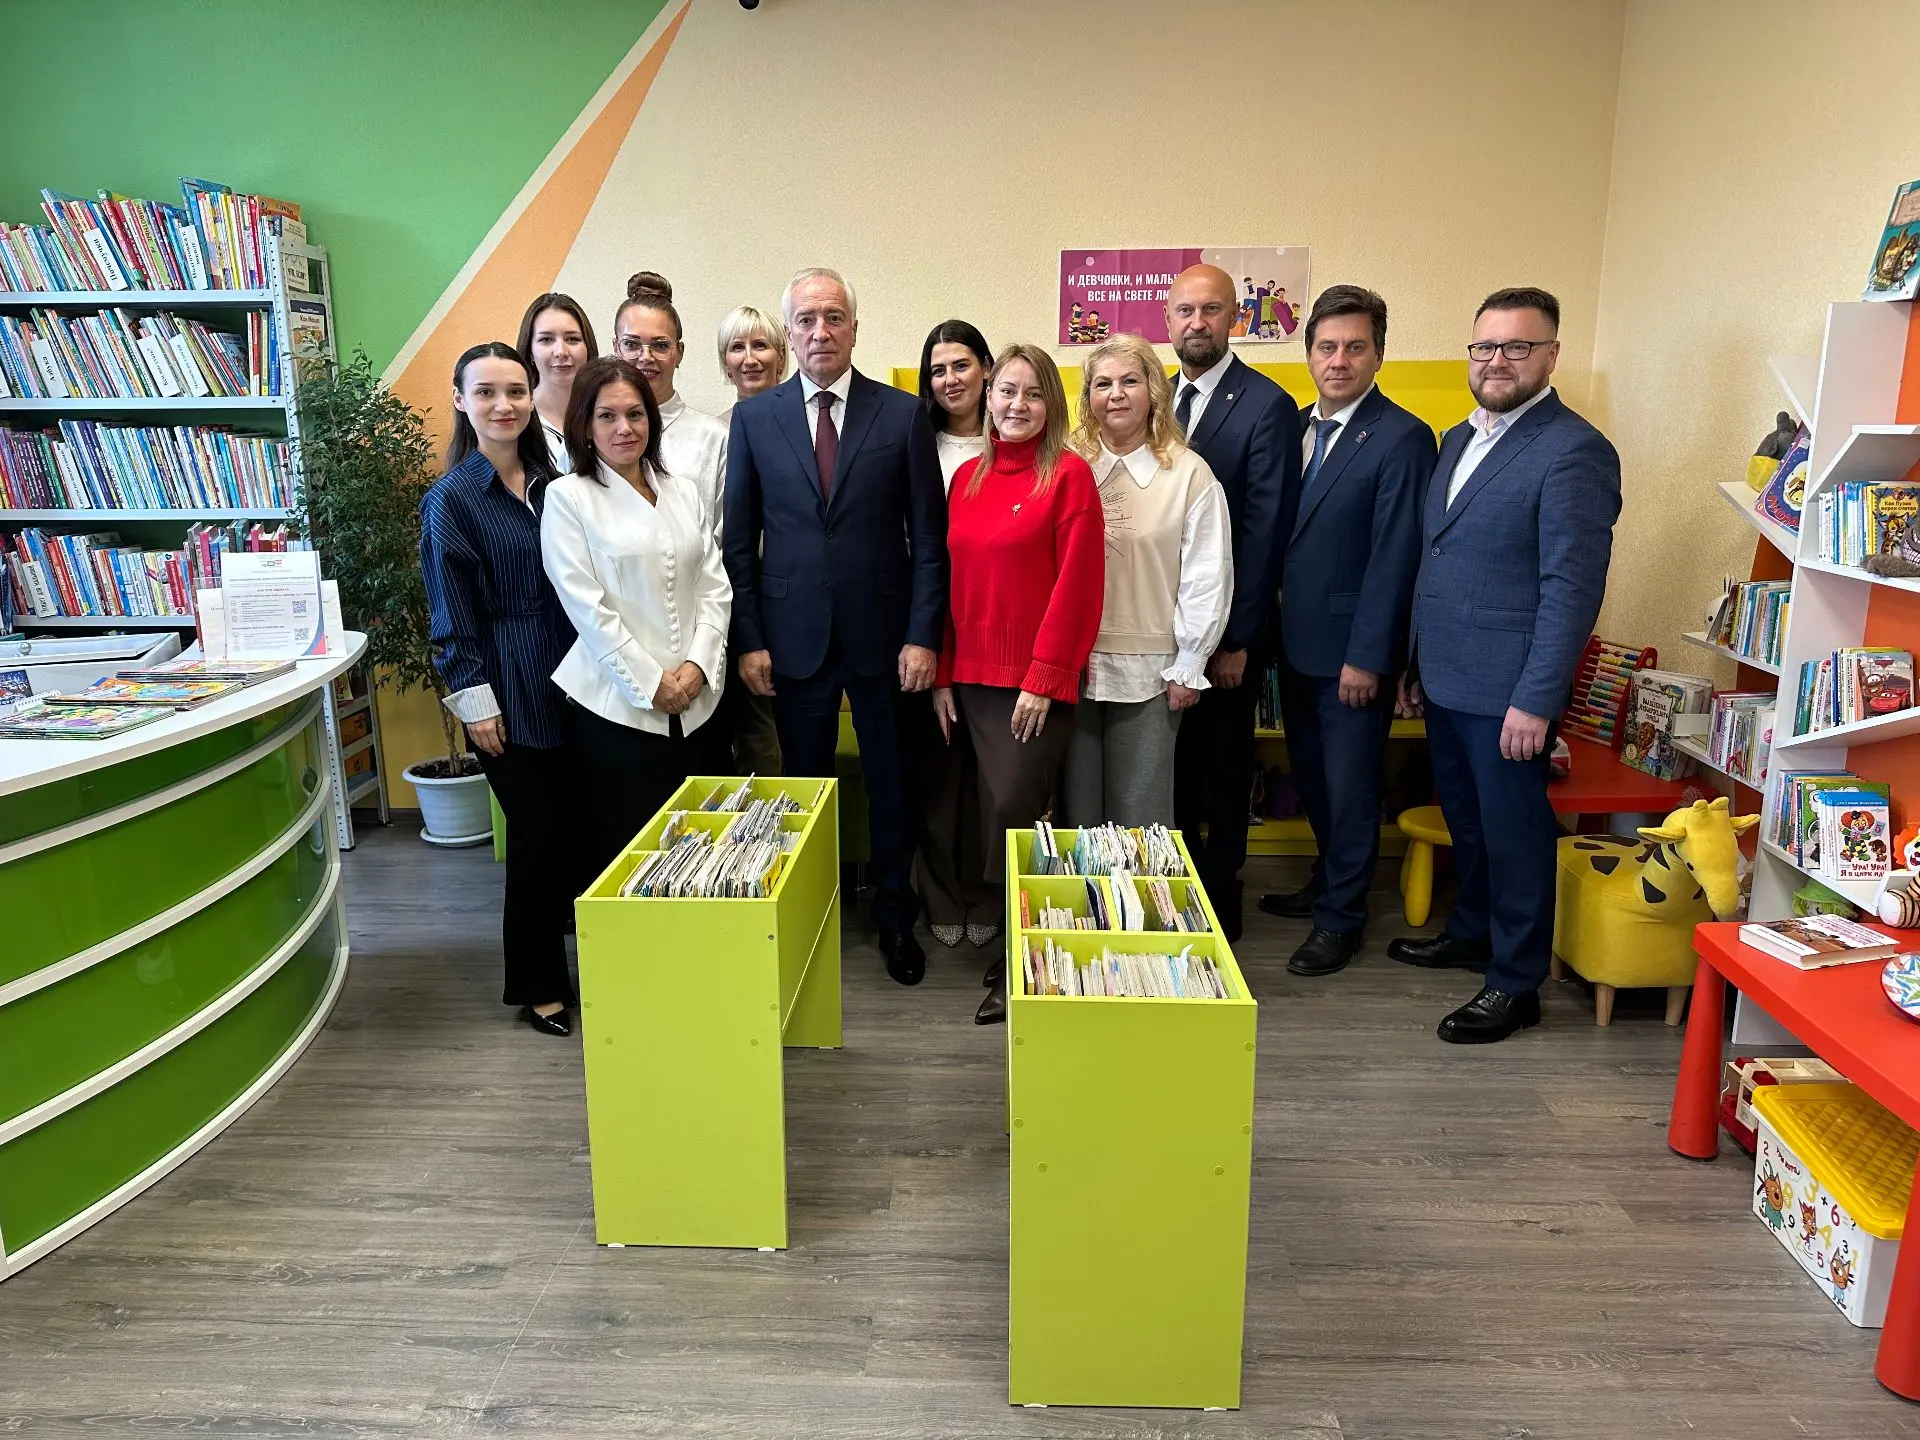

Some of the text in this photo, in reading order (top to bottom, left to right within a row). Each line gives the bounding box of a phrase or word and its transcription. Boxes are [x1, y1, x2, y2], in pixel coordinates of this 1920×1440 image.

[93, 238, 118, 281] Почемучки
[1068, 273, 1180, 287] И ДЕВЧОНКИ, И МАЛЬ
[1087, 290, 1106, 302] ВСЕ
[1109, 290, 1121, 301] НА
[1124, 289, 1153, 301] СВЕТЕ
[1840, 869, 1847, 877] Я
[1763, 1140, 1769, 1156] 2
[1788, 1214, 1795, 1229] 9
[1830, 1204, 1840, 1227] 6
[1842, 1239, 1849, 1254] 3
[1817, 1250, 1824, 1269] 5
